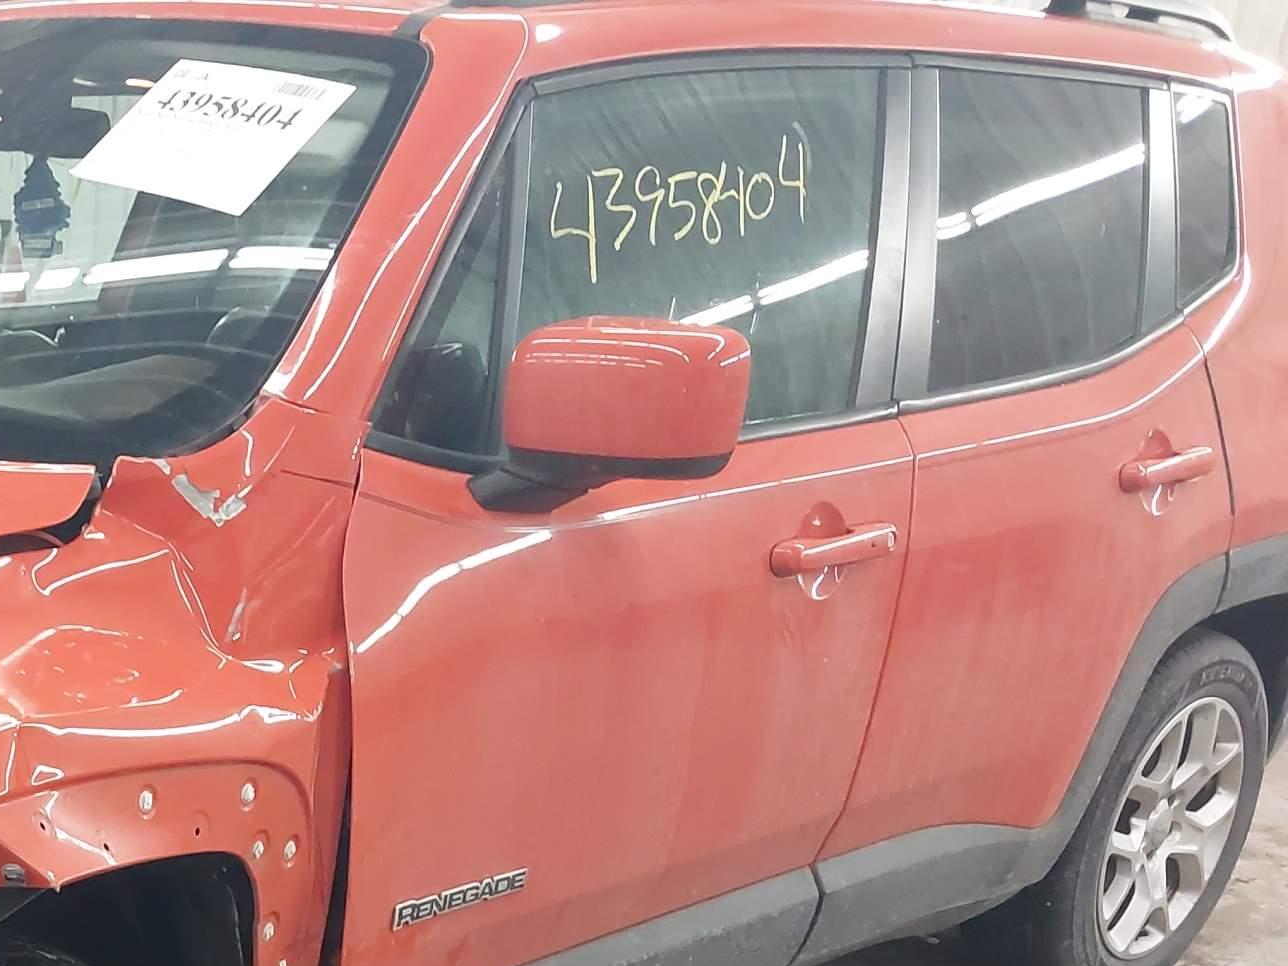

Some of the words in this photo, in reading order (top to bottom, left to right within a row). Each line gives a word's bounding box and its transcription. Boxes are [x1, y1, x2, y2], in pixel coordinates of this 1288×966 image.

[157, 89, 302, 131] 43958404
[550, 134, 808, 285] 43958404
[393, 868, 528, 931] RENEGADE
